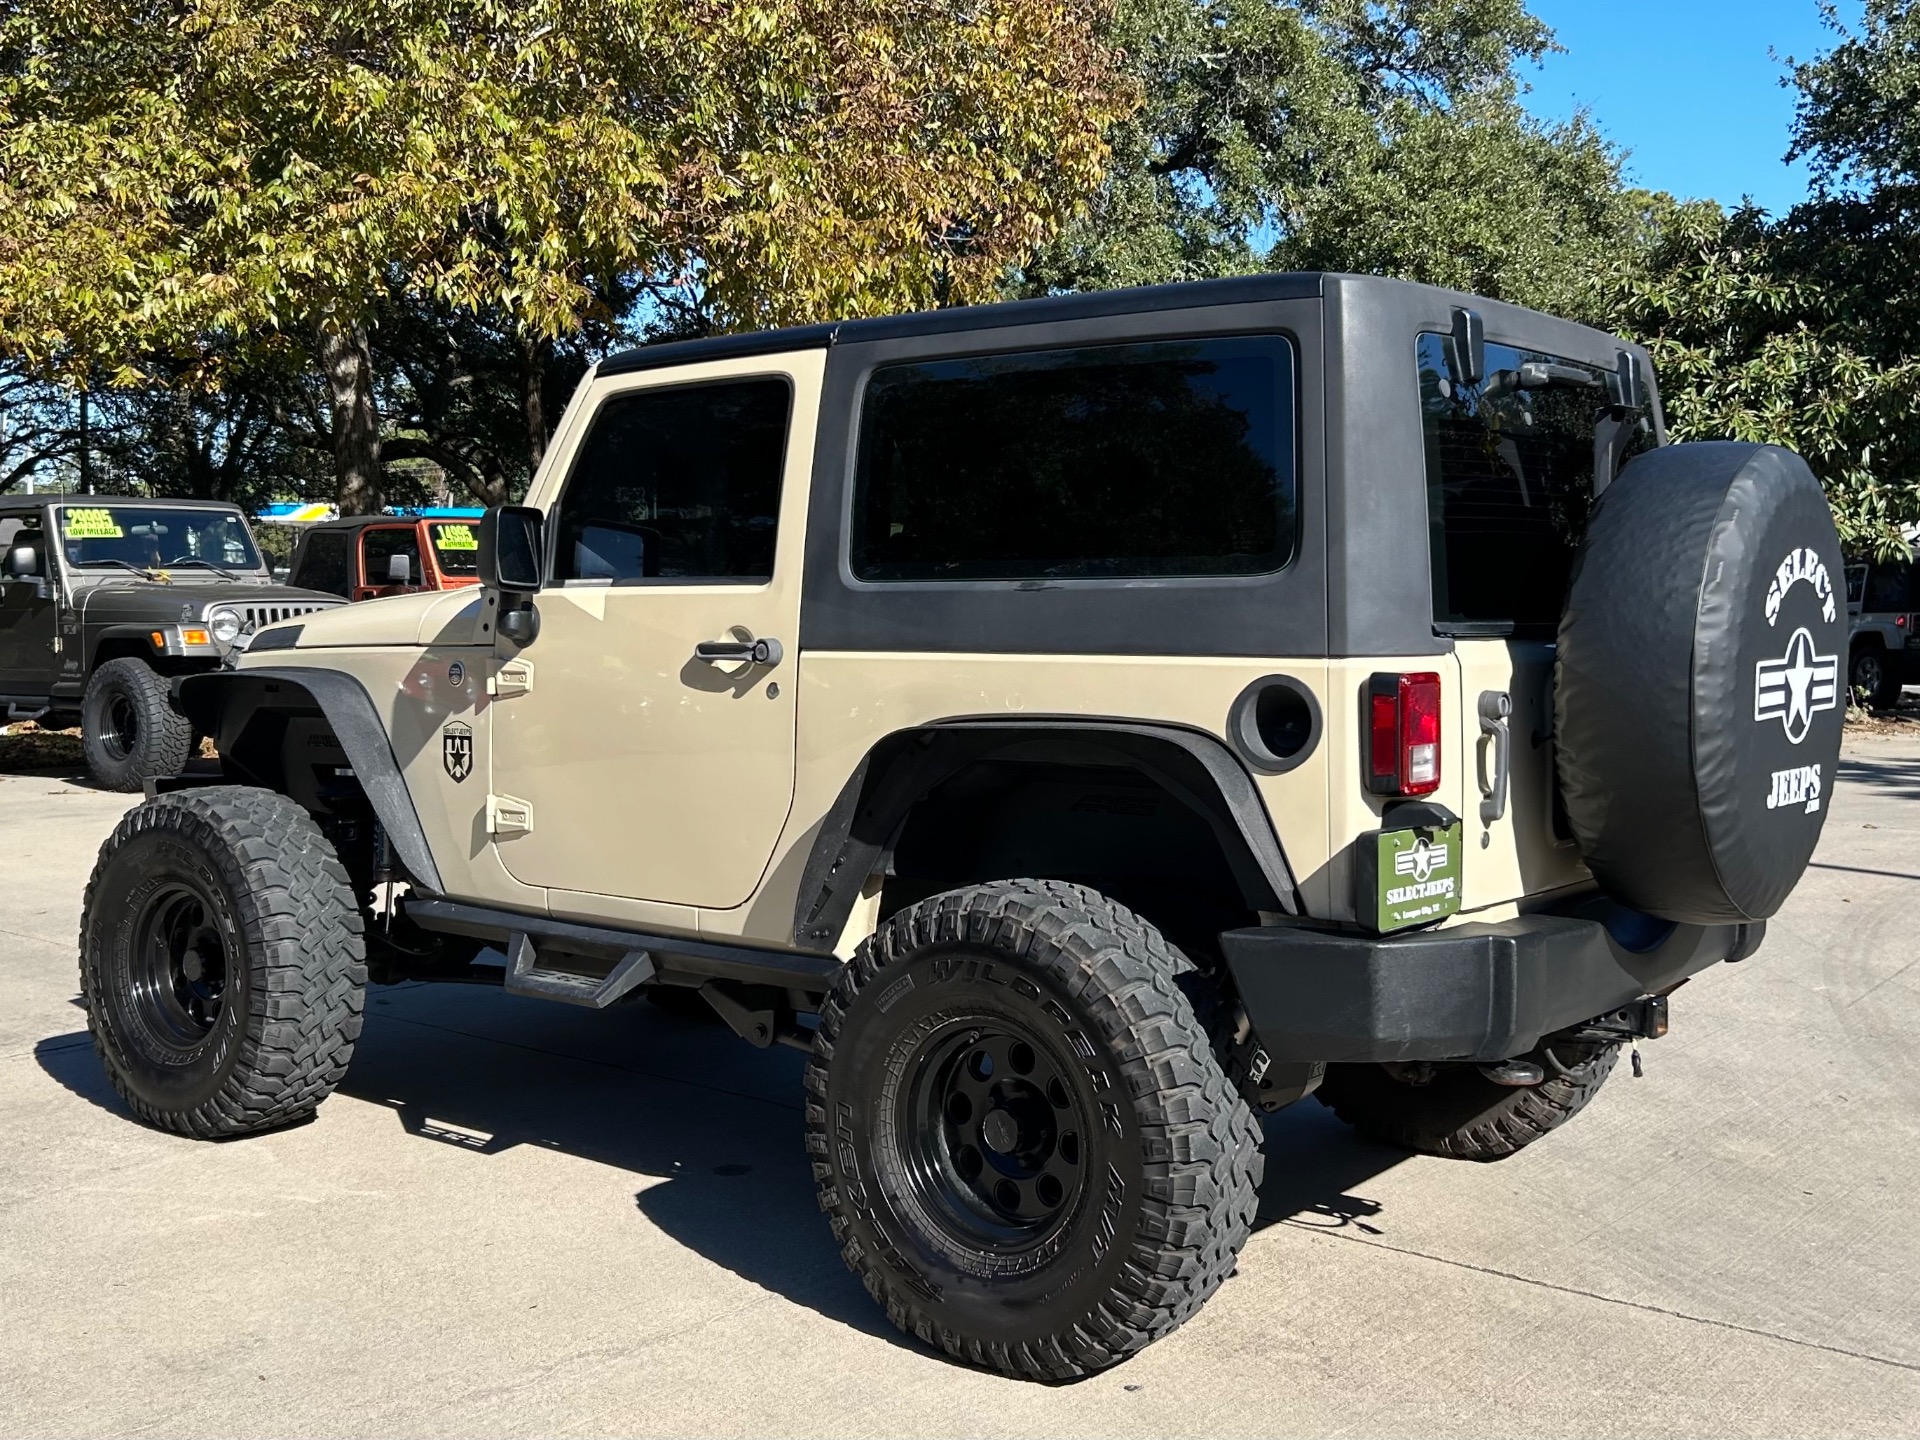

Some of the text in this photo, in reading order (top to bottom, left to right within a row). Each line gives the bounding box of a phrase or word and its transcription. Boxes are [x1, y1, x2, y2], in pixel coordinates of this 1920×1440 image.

[66, 508, 114, 528] 29995
[70, 528, 118, 536] LOW MILEAGE
[437, 525, 474, 541] 14995
[1764, 547, 1837, 627] SELECT
[1766, 763, 1822, 809] JEEPS
[927, 958, 1124, 1140] WILDPEAK
